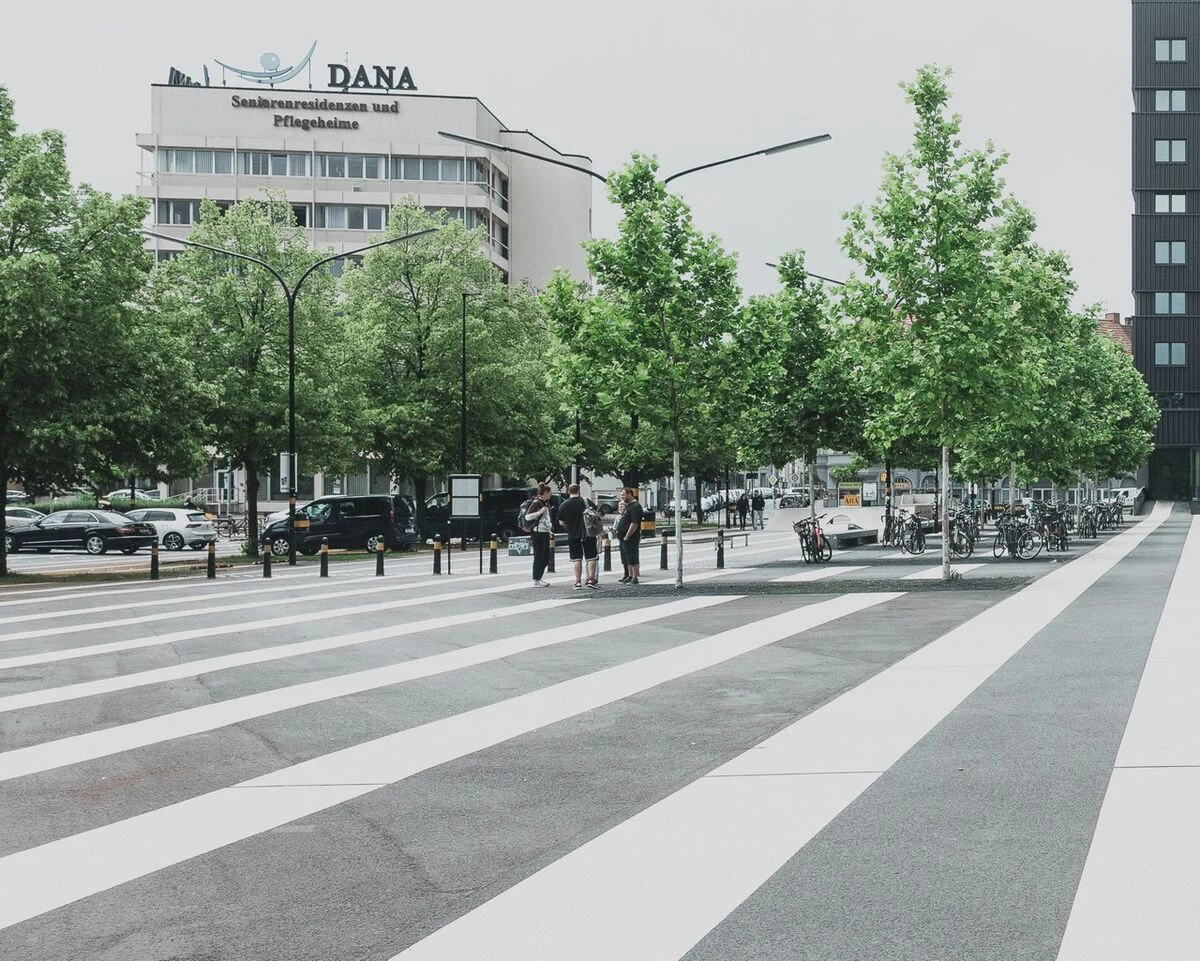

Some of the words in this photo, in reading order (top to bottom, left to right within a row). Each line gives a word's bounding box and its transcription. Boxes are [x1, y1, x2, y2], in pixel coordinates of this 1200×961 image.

[327, 64, 418, 90] DANA
[231, 95, 369, 113] Seniorenresidenzen
[372, 100, 400, 114] und
[273, 114, 360, 131] Pflegeheime
